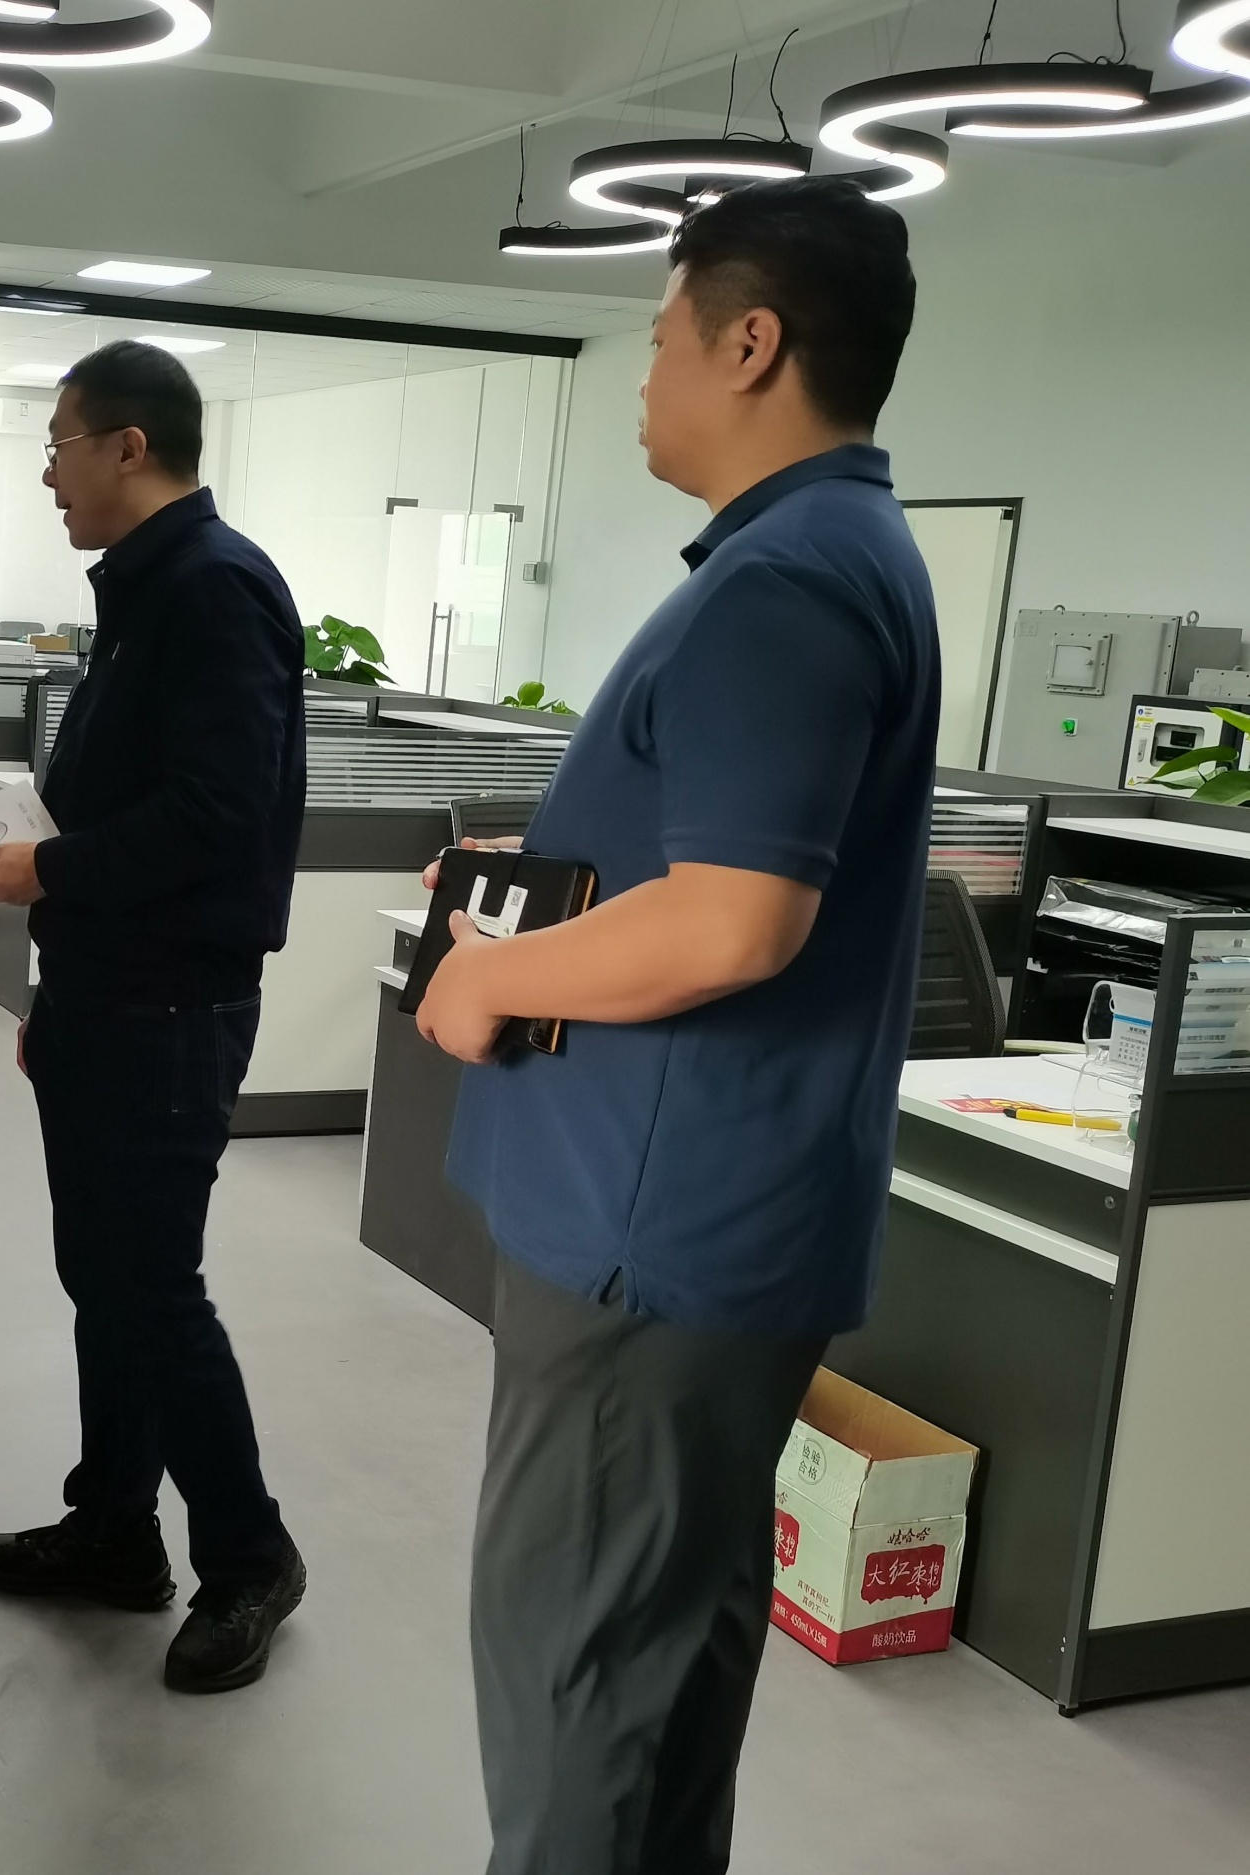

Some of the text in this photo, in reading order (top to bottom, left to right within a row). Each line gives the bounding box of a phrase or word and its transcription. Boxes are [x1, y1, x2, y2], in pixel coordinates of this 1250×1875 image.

[887, 1526, 931, 1545] 娃哈哈
[871, 1629, 917, 1648] 酸奶饮品
